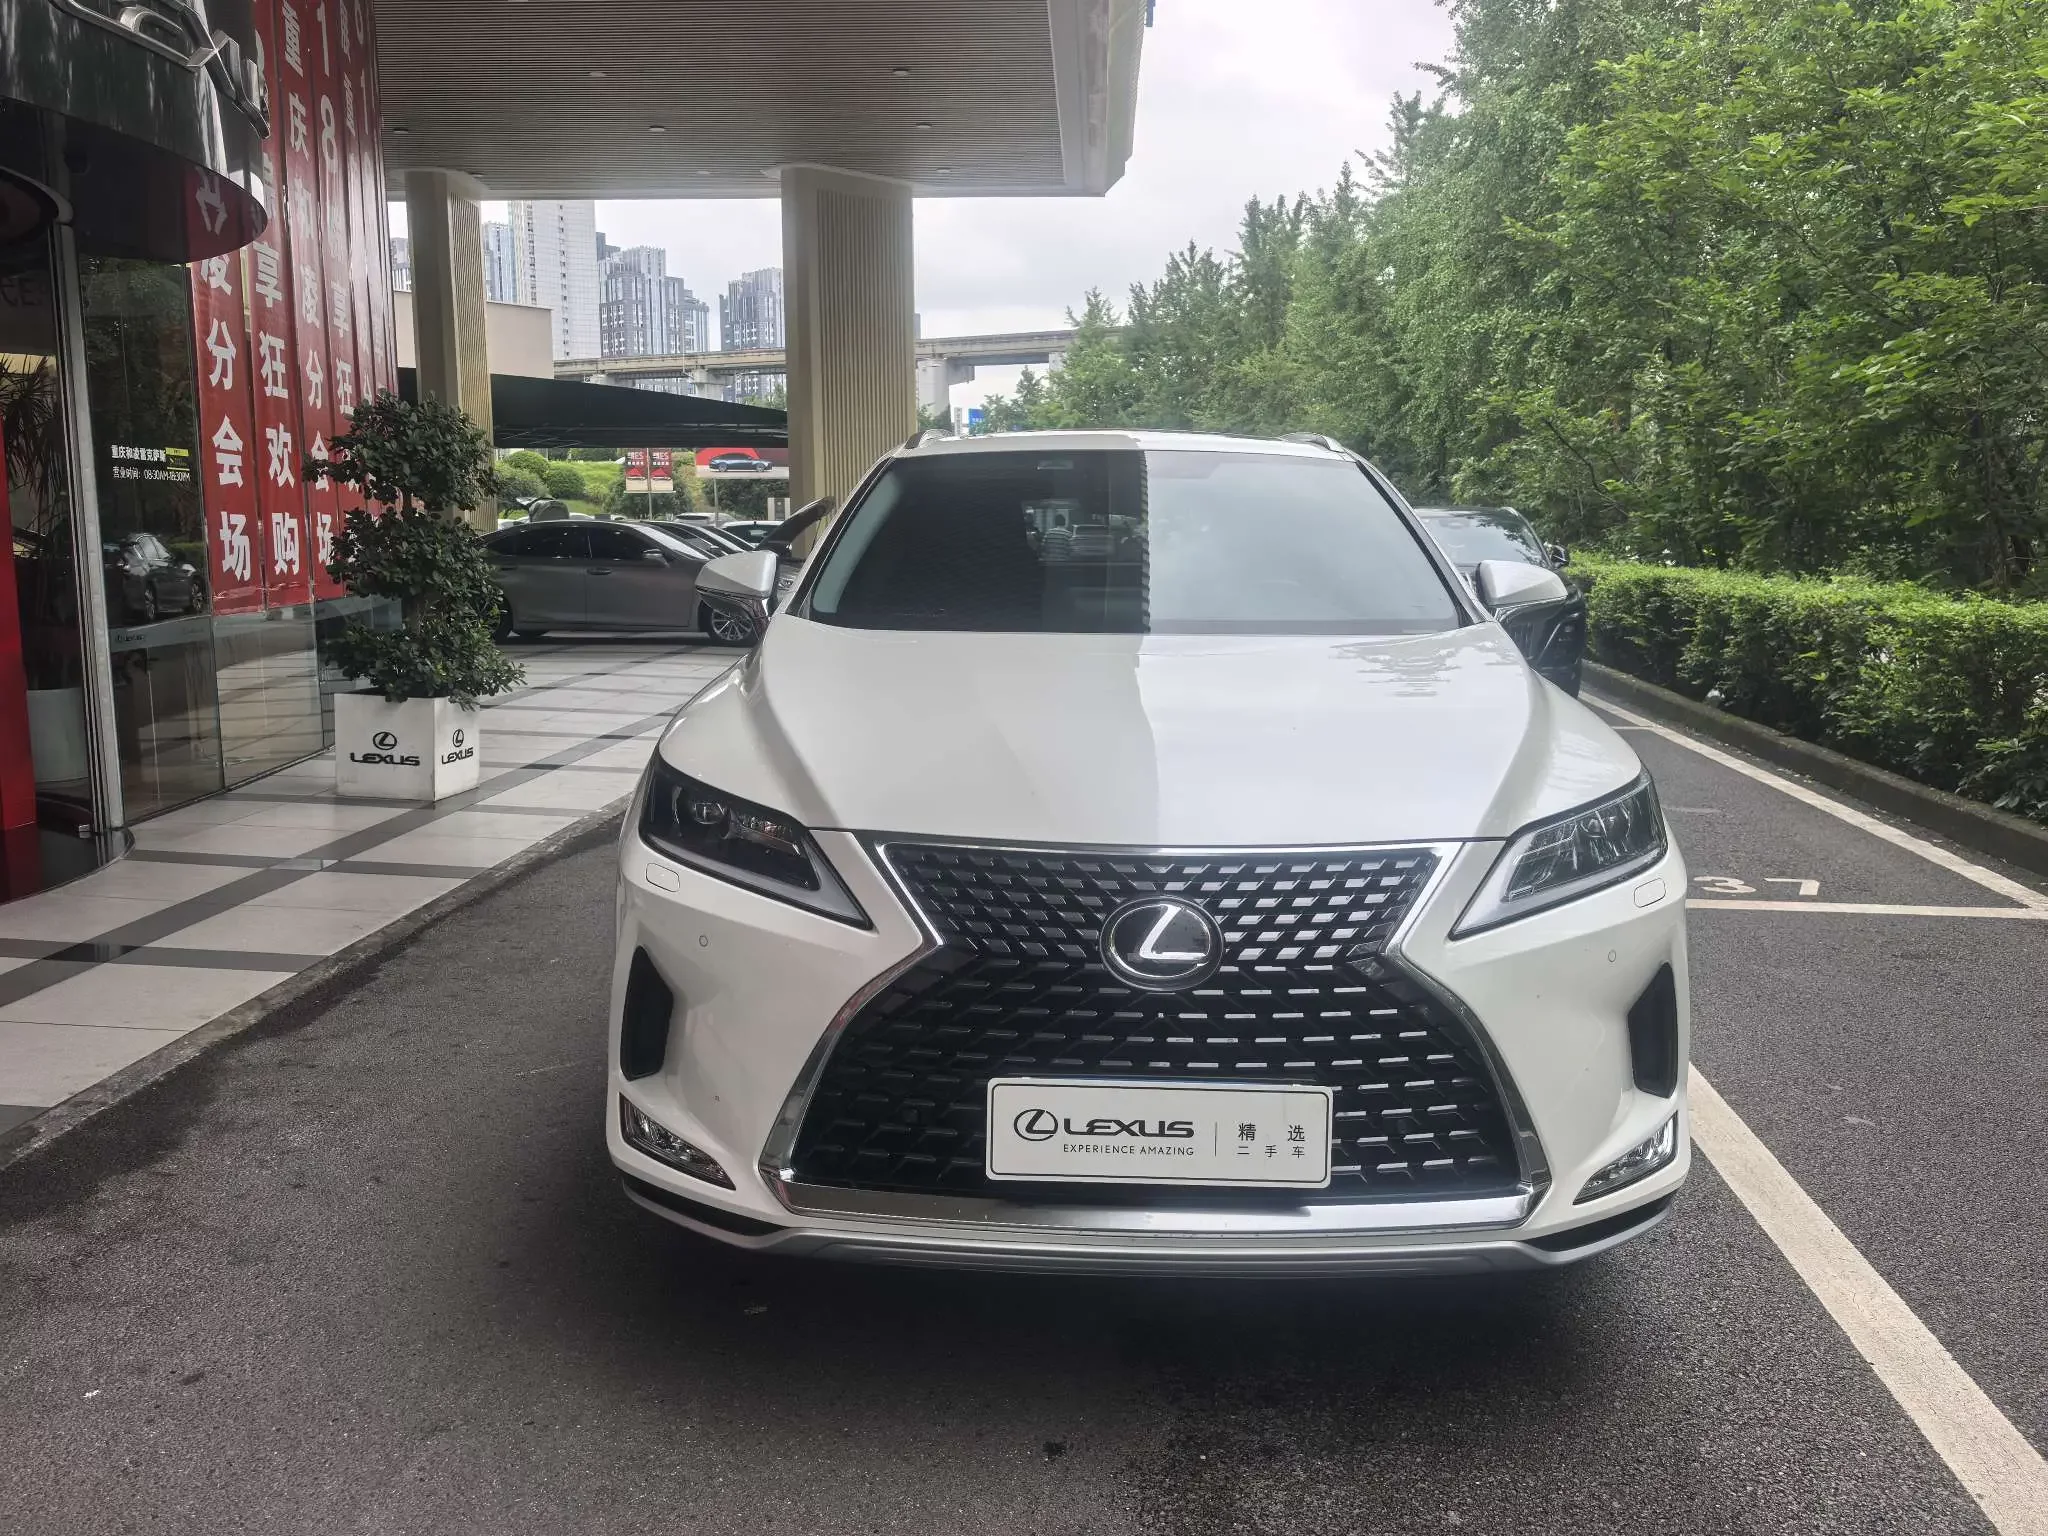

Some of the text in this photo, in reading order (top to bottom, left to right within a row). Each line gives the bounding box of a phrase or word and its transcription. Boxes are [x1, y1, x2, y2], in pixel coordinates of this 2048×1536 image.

[349, 752, 420, 766] LEXUS
[441, 747, 474, 765] LEXUS
[1063, 1118, 1195, 1138] LEXUS
[1063, 1143, 1195, 1156] EXPERIENCE AMAZING
